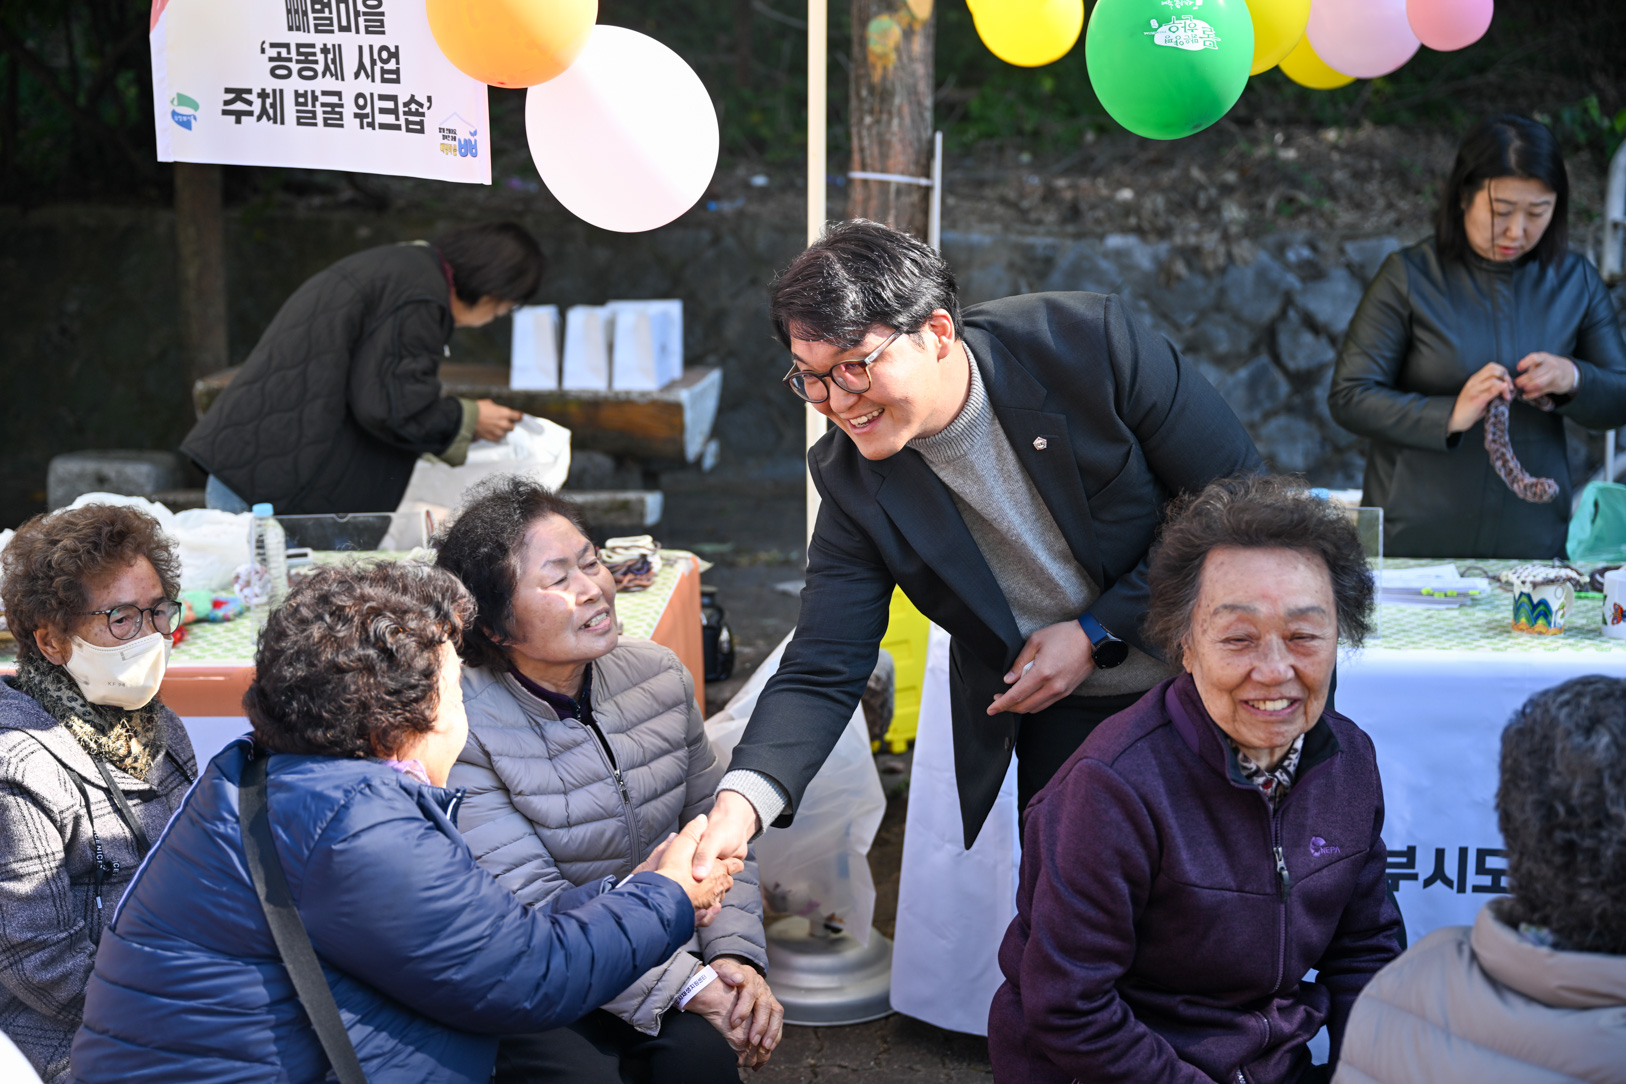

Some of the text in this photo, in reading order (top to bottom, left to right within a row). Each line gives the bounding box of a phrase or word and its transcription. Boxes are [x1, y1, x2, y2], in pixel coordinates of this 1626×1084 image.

[260, 40, 401, 84] ‘공동체 사업
[221, 87, 433, 134] 주체 발굴 워크숍’
